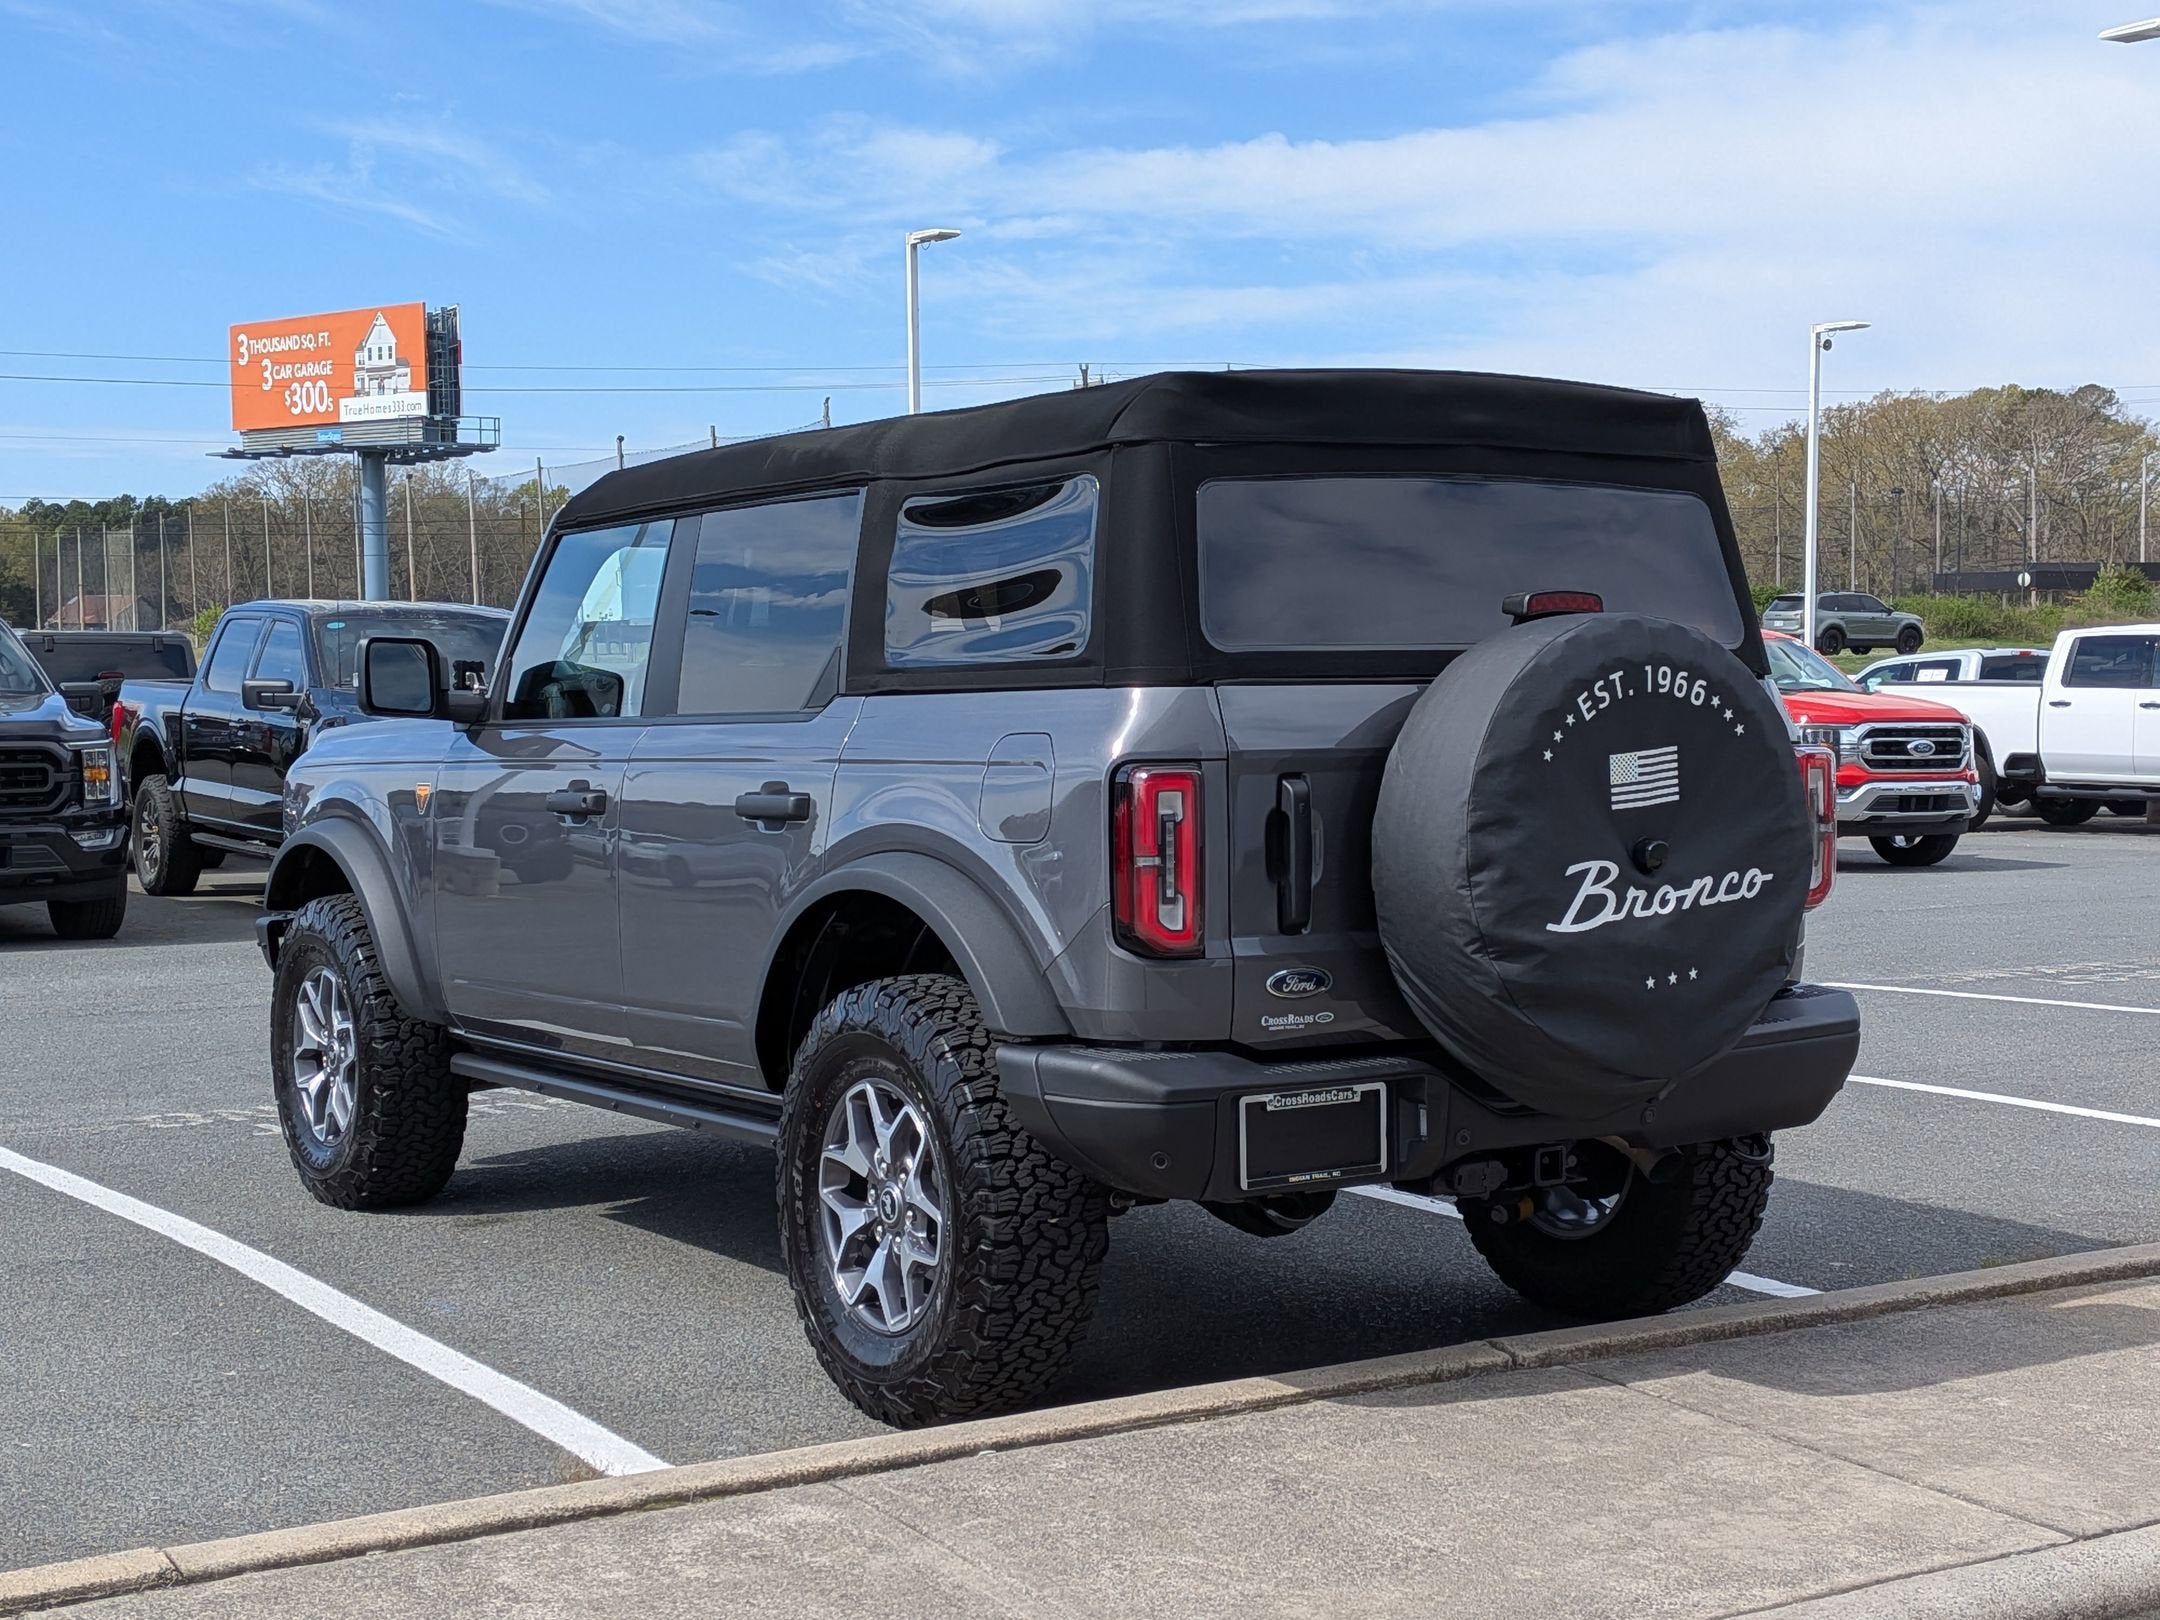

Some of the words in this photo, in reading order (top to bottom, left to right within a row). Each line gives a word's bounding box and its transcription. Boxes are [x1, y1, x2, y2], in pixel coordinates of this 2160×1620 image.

[237, 333, 249, 366] 3
[248, 335, 301, 355] THOUSAND
[301, 333, 317, 351] SQ.
[318, 331, 332, 347] FT.
[261, 358, 273, 391] 3
[273, 365, 293, 380] CAR
[294, 360, 334, 378] GARAGE
[343, 401, 423, 416] TrueHomes333.com
[1576, 671, 1634, 721] EST.
[1644, 665, 1707, 706] 1966
[1546, 860, 1774, 933] Bronco
[1282, 974, 1317, 993] Ford
[1274, 1090, 1354, 1107] CrossRoadsCars
